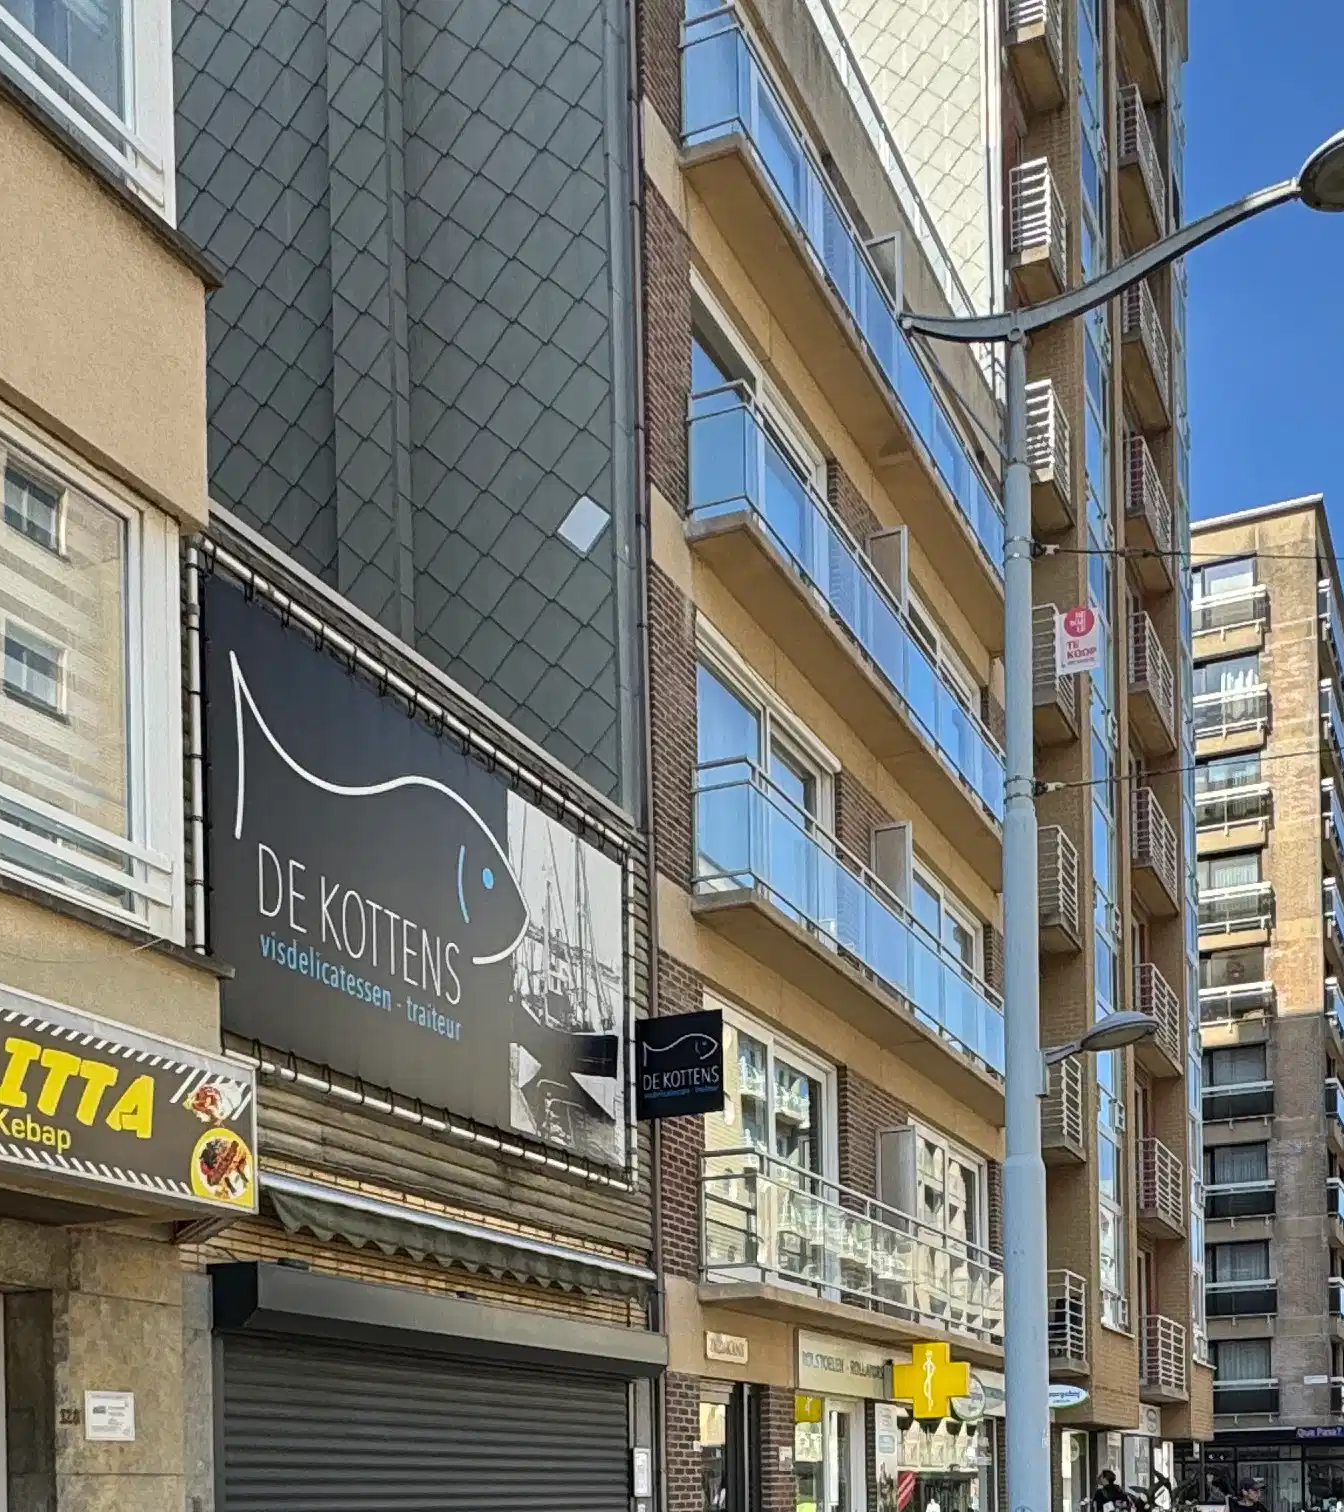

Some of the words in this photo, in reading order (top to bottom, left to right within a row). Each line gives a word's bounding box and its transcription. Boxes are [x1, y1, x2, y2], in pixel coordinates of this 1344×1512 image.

[259, 843, 307, 934] DE
[321, 876, 461, 1005] KOTTENS
[260, 932, 392, 1011] visdelicatessen
[406, 996, 462, 1041] traiteur
[643, 1072, 661, 1091] DE
[663, 1065, 719, 1088] KOTTENS
